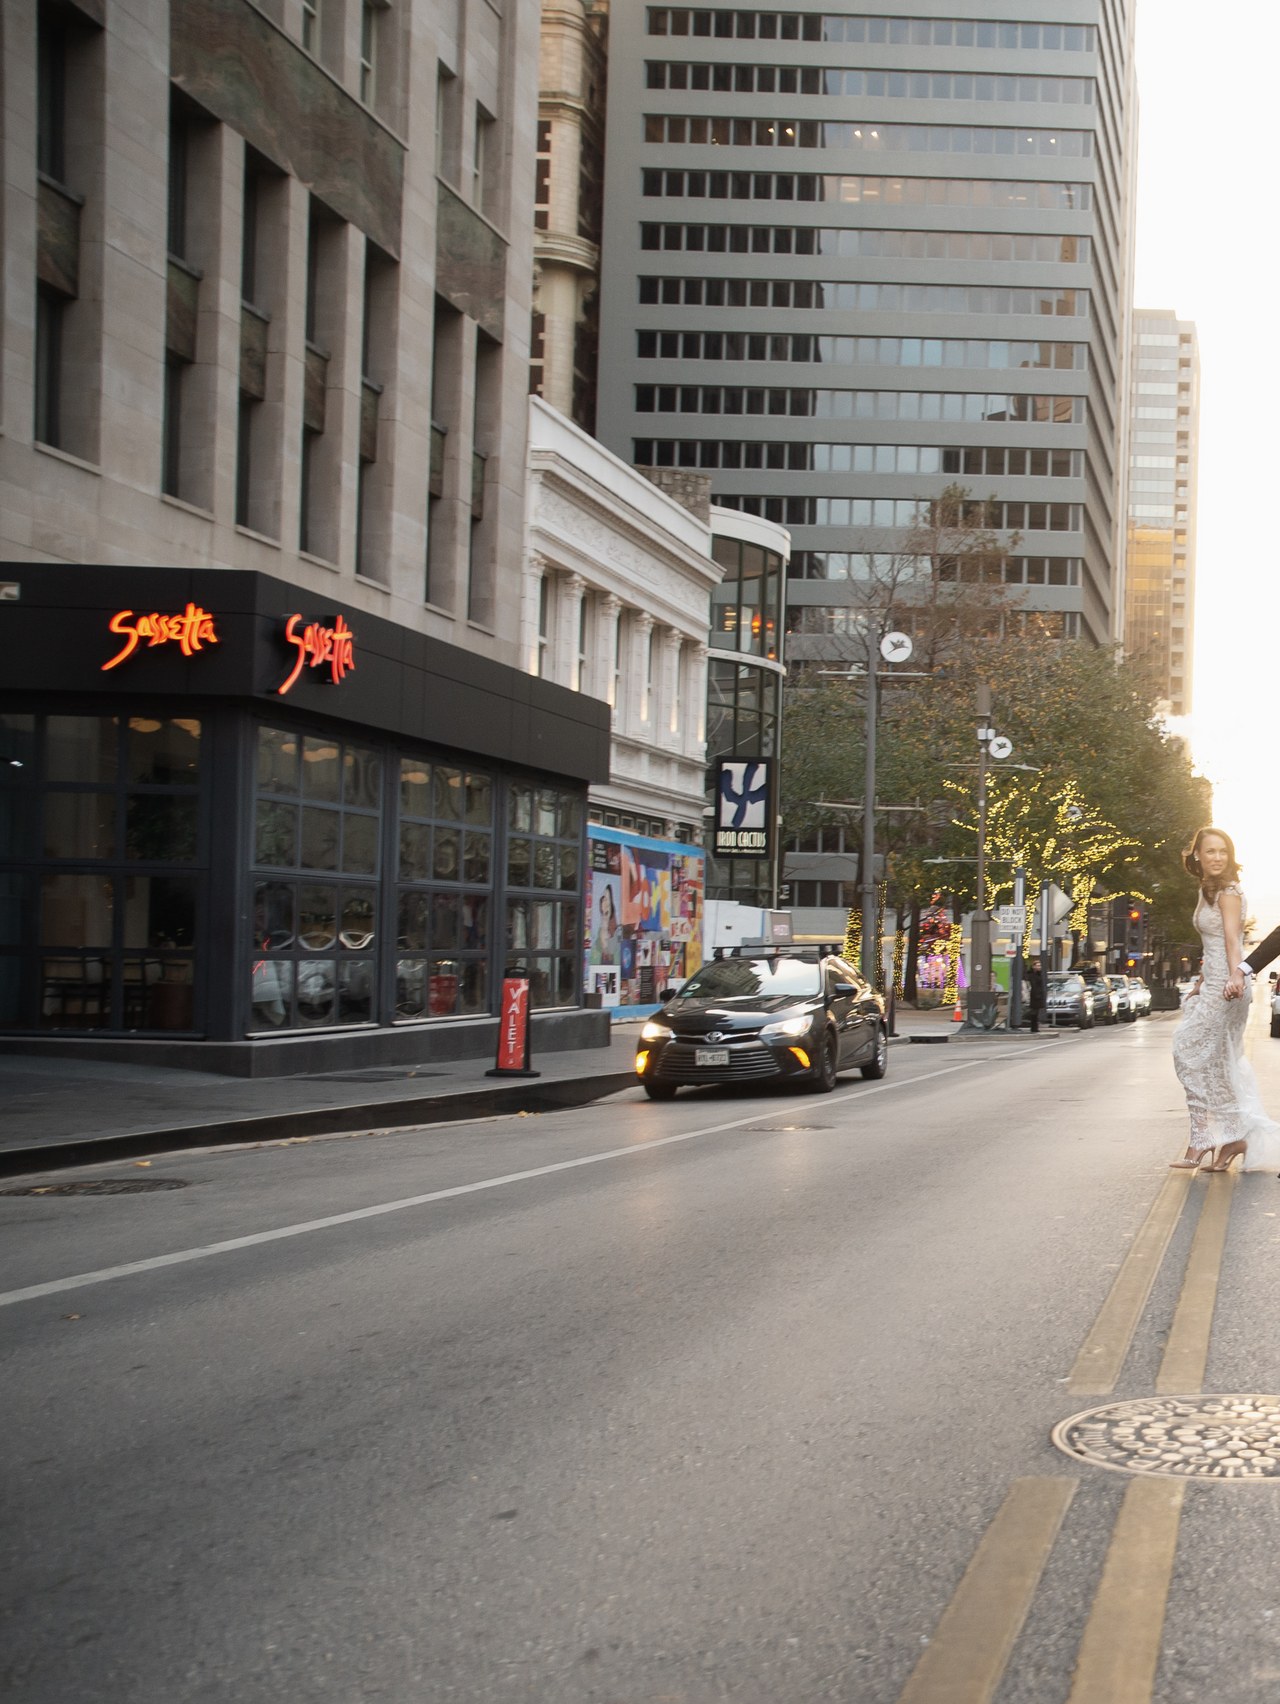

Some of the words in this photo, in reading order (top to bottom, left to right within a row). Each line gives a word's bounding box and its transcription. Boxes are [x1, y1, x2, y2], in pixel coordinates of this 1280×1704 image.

[101, 602, 218, 671] Sassetta
[278, 613, 355, 695] Sassetta
[716, 831, 737, 847] IRON
[737, 831, 766, 848] CACTUS
[507, 987, 520, 1054] VALET
